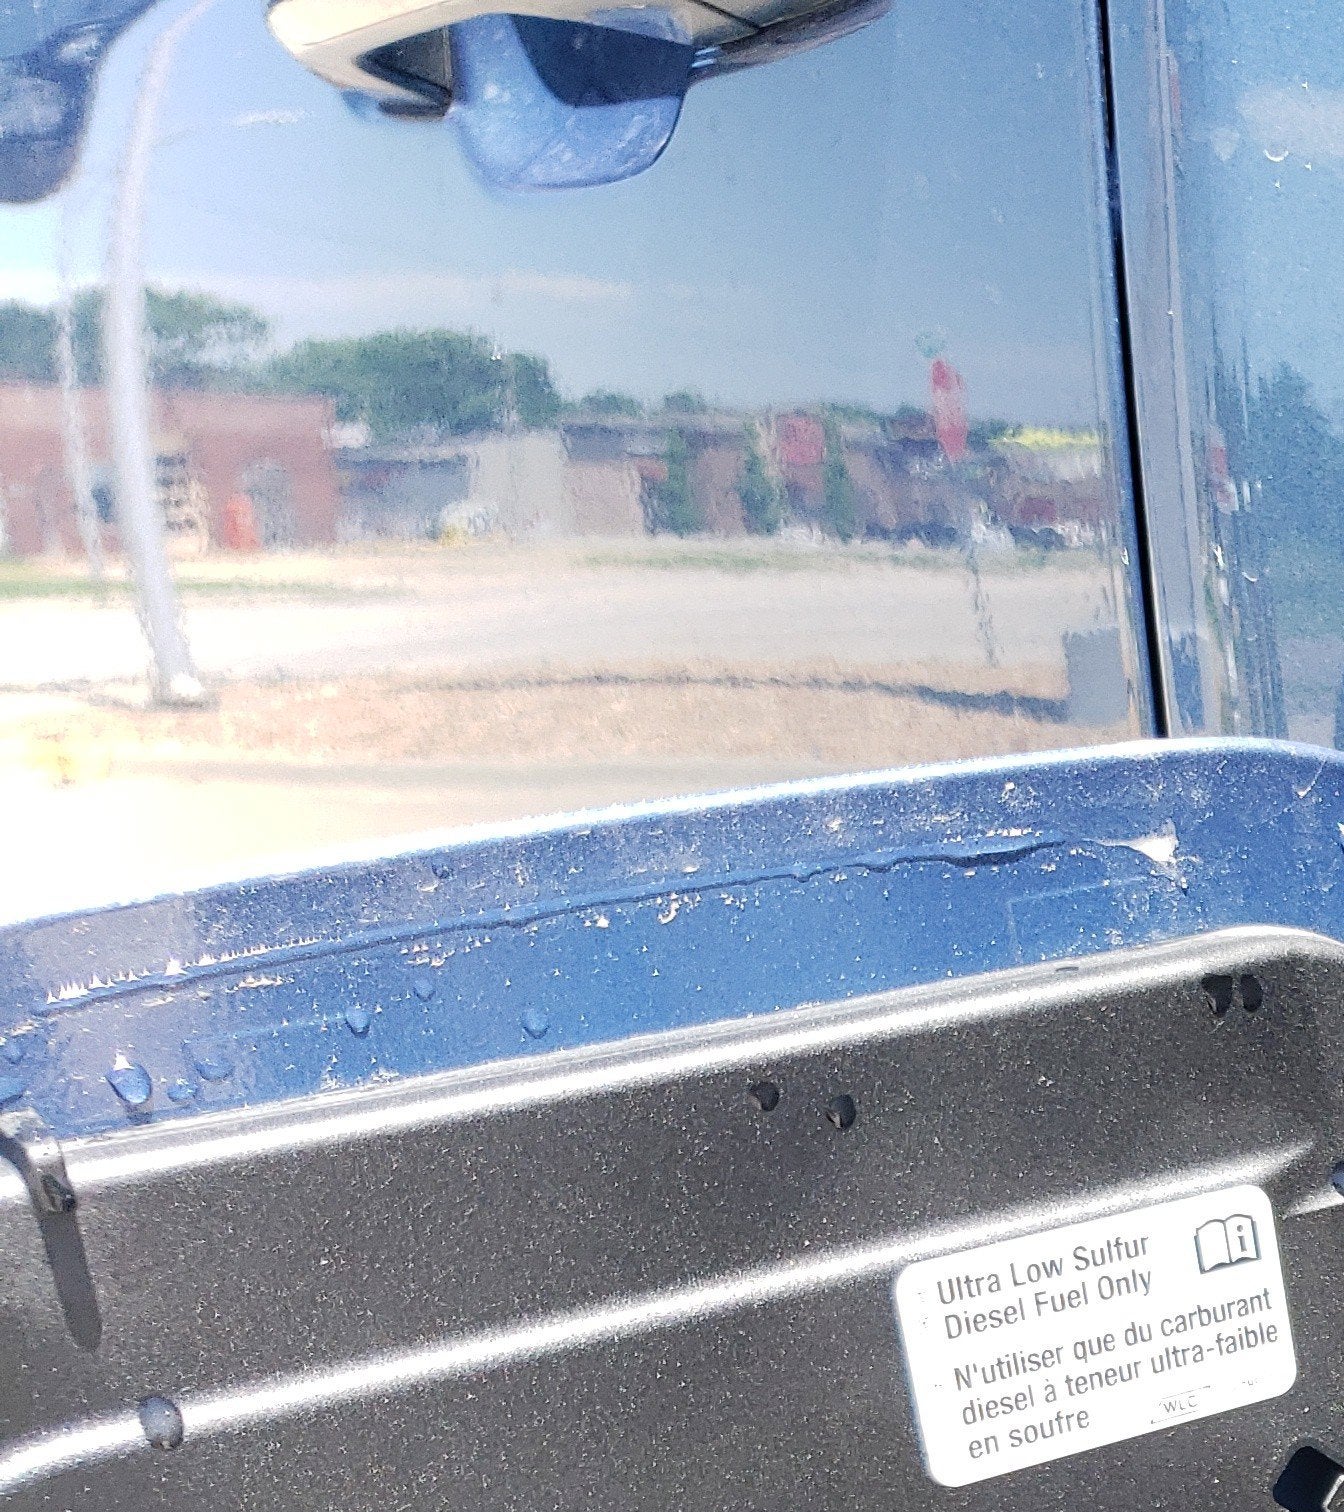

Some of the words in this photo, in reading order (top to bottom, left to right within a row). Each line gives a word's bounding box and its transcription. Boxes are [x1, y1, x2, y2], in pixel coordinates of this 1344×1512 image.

[937, 1273, 1001, 1305] Ultra
[1010, 1257, 1063, 1288] Low
[1072, 1235, 1149, 1271] Sulfur
[944, 1297, 1025, 1340] Diesel
[1035, 1281, 1089, 1317] Fuel
[1098, 1268, 1151, 1301] Only
[953, 1345, 1063, 1391] N'utiliser
[1073, 1333, 1115, 1364] que
[1124, 1321, 1152, 1347] du
[1161, 1287, 1272, 1337] carburant
[962, 1384, 1034, 1426] diesel
[1044, 1377, 1057, 1404] à
[1065, 1357, 1142, 1397] teneur
[1151, 1321, 1278, 1375] ultra-faible
[968, 1435, 999, 1459] en
[1008, 1408, 1090, 1448] soufre
